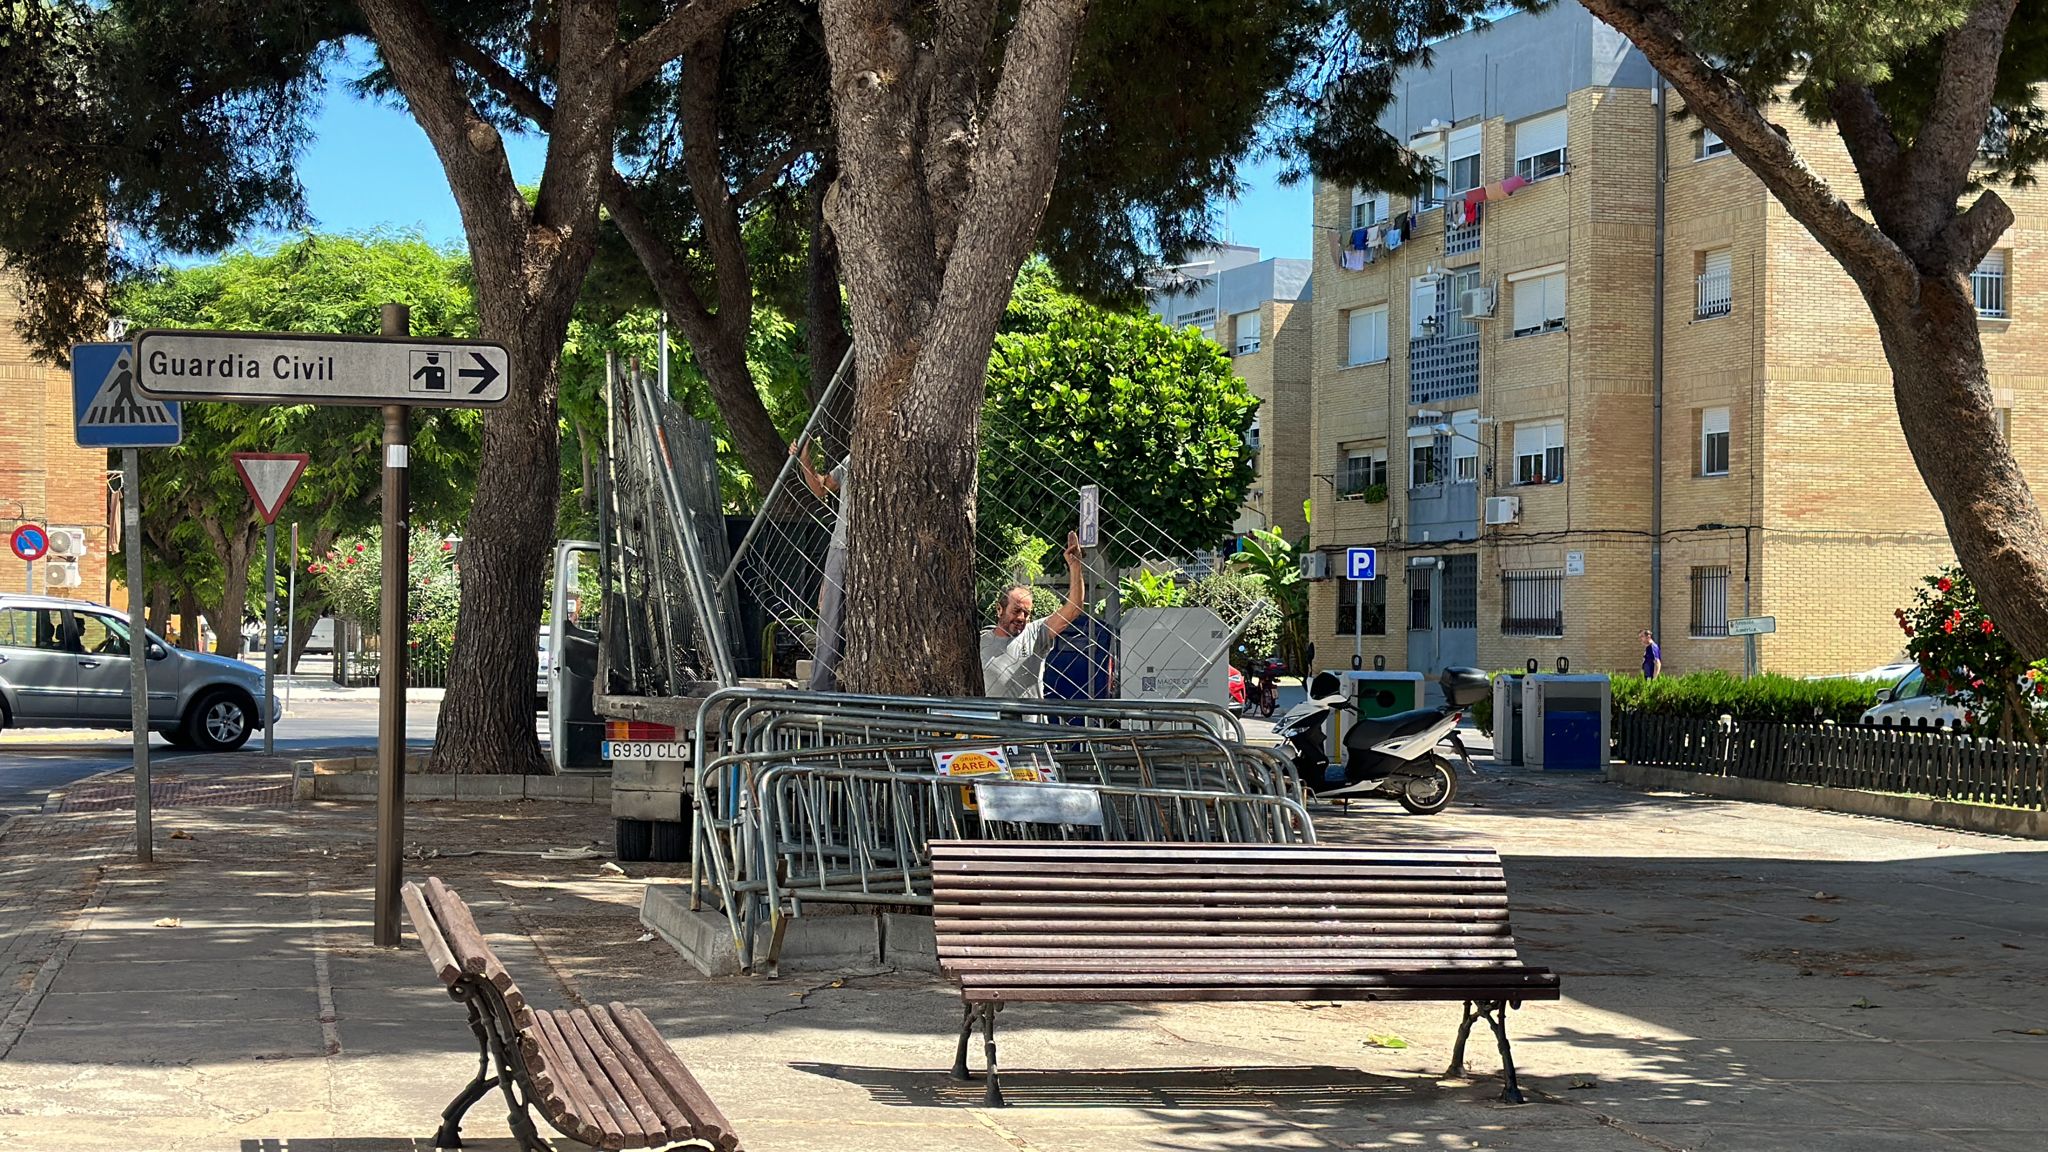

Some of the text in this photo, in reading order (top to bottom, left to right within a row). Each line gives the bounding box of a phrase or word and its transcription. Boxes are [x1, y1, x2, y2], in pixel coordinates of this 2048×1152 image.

[149, 350, 333, 381] Guardia Civil
[1353, 552, 1370, 577] P
[613, 743, 686, 758] 6930 CLC
[952, 761, 995, 771] BAREA
